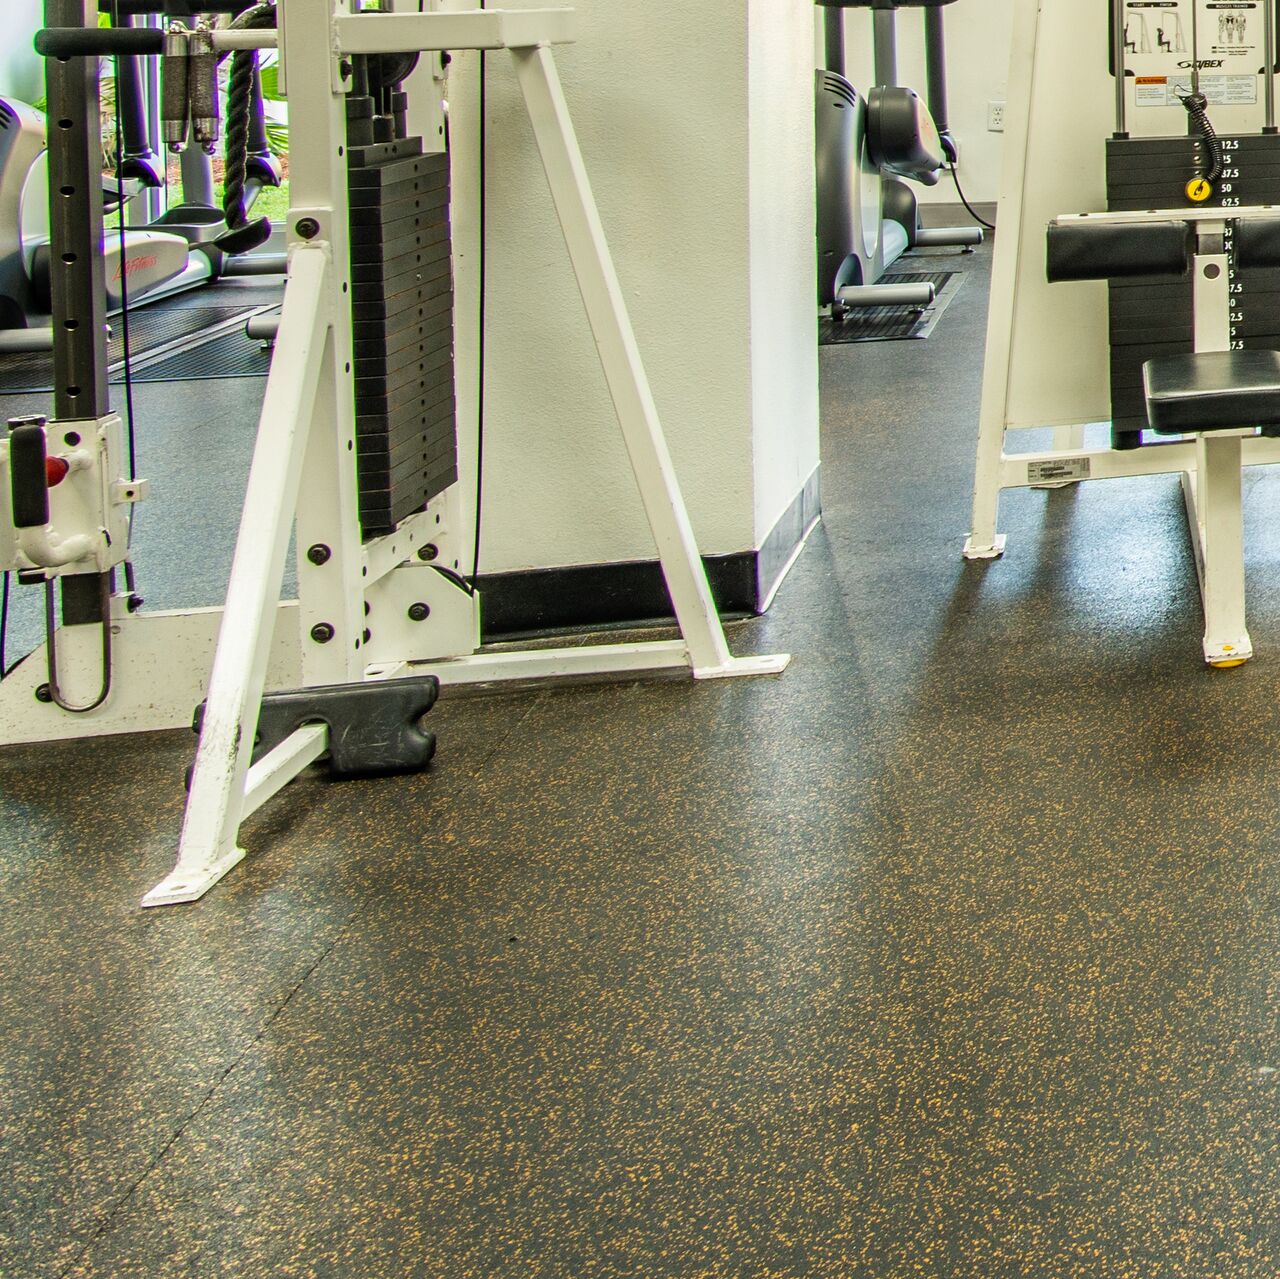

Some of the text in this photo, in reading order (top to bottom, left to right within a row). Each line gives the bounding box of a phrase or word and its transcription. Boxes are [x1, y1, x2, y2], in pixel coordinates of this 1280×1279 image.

[1221, 141, 1239, 149] 12.5
[1221, 184, 1231, 192] 50
[1222, 198, 1239, 206] 62.5
